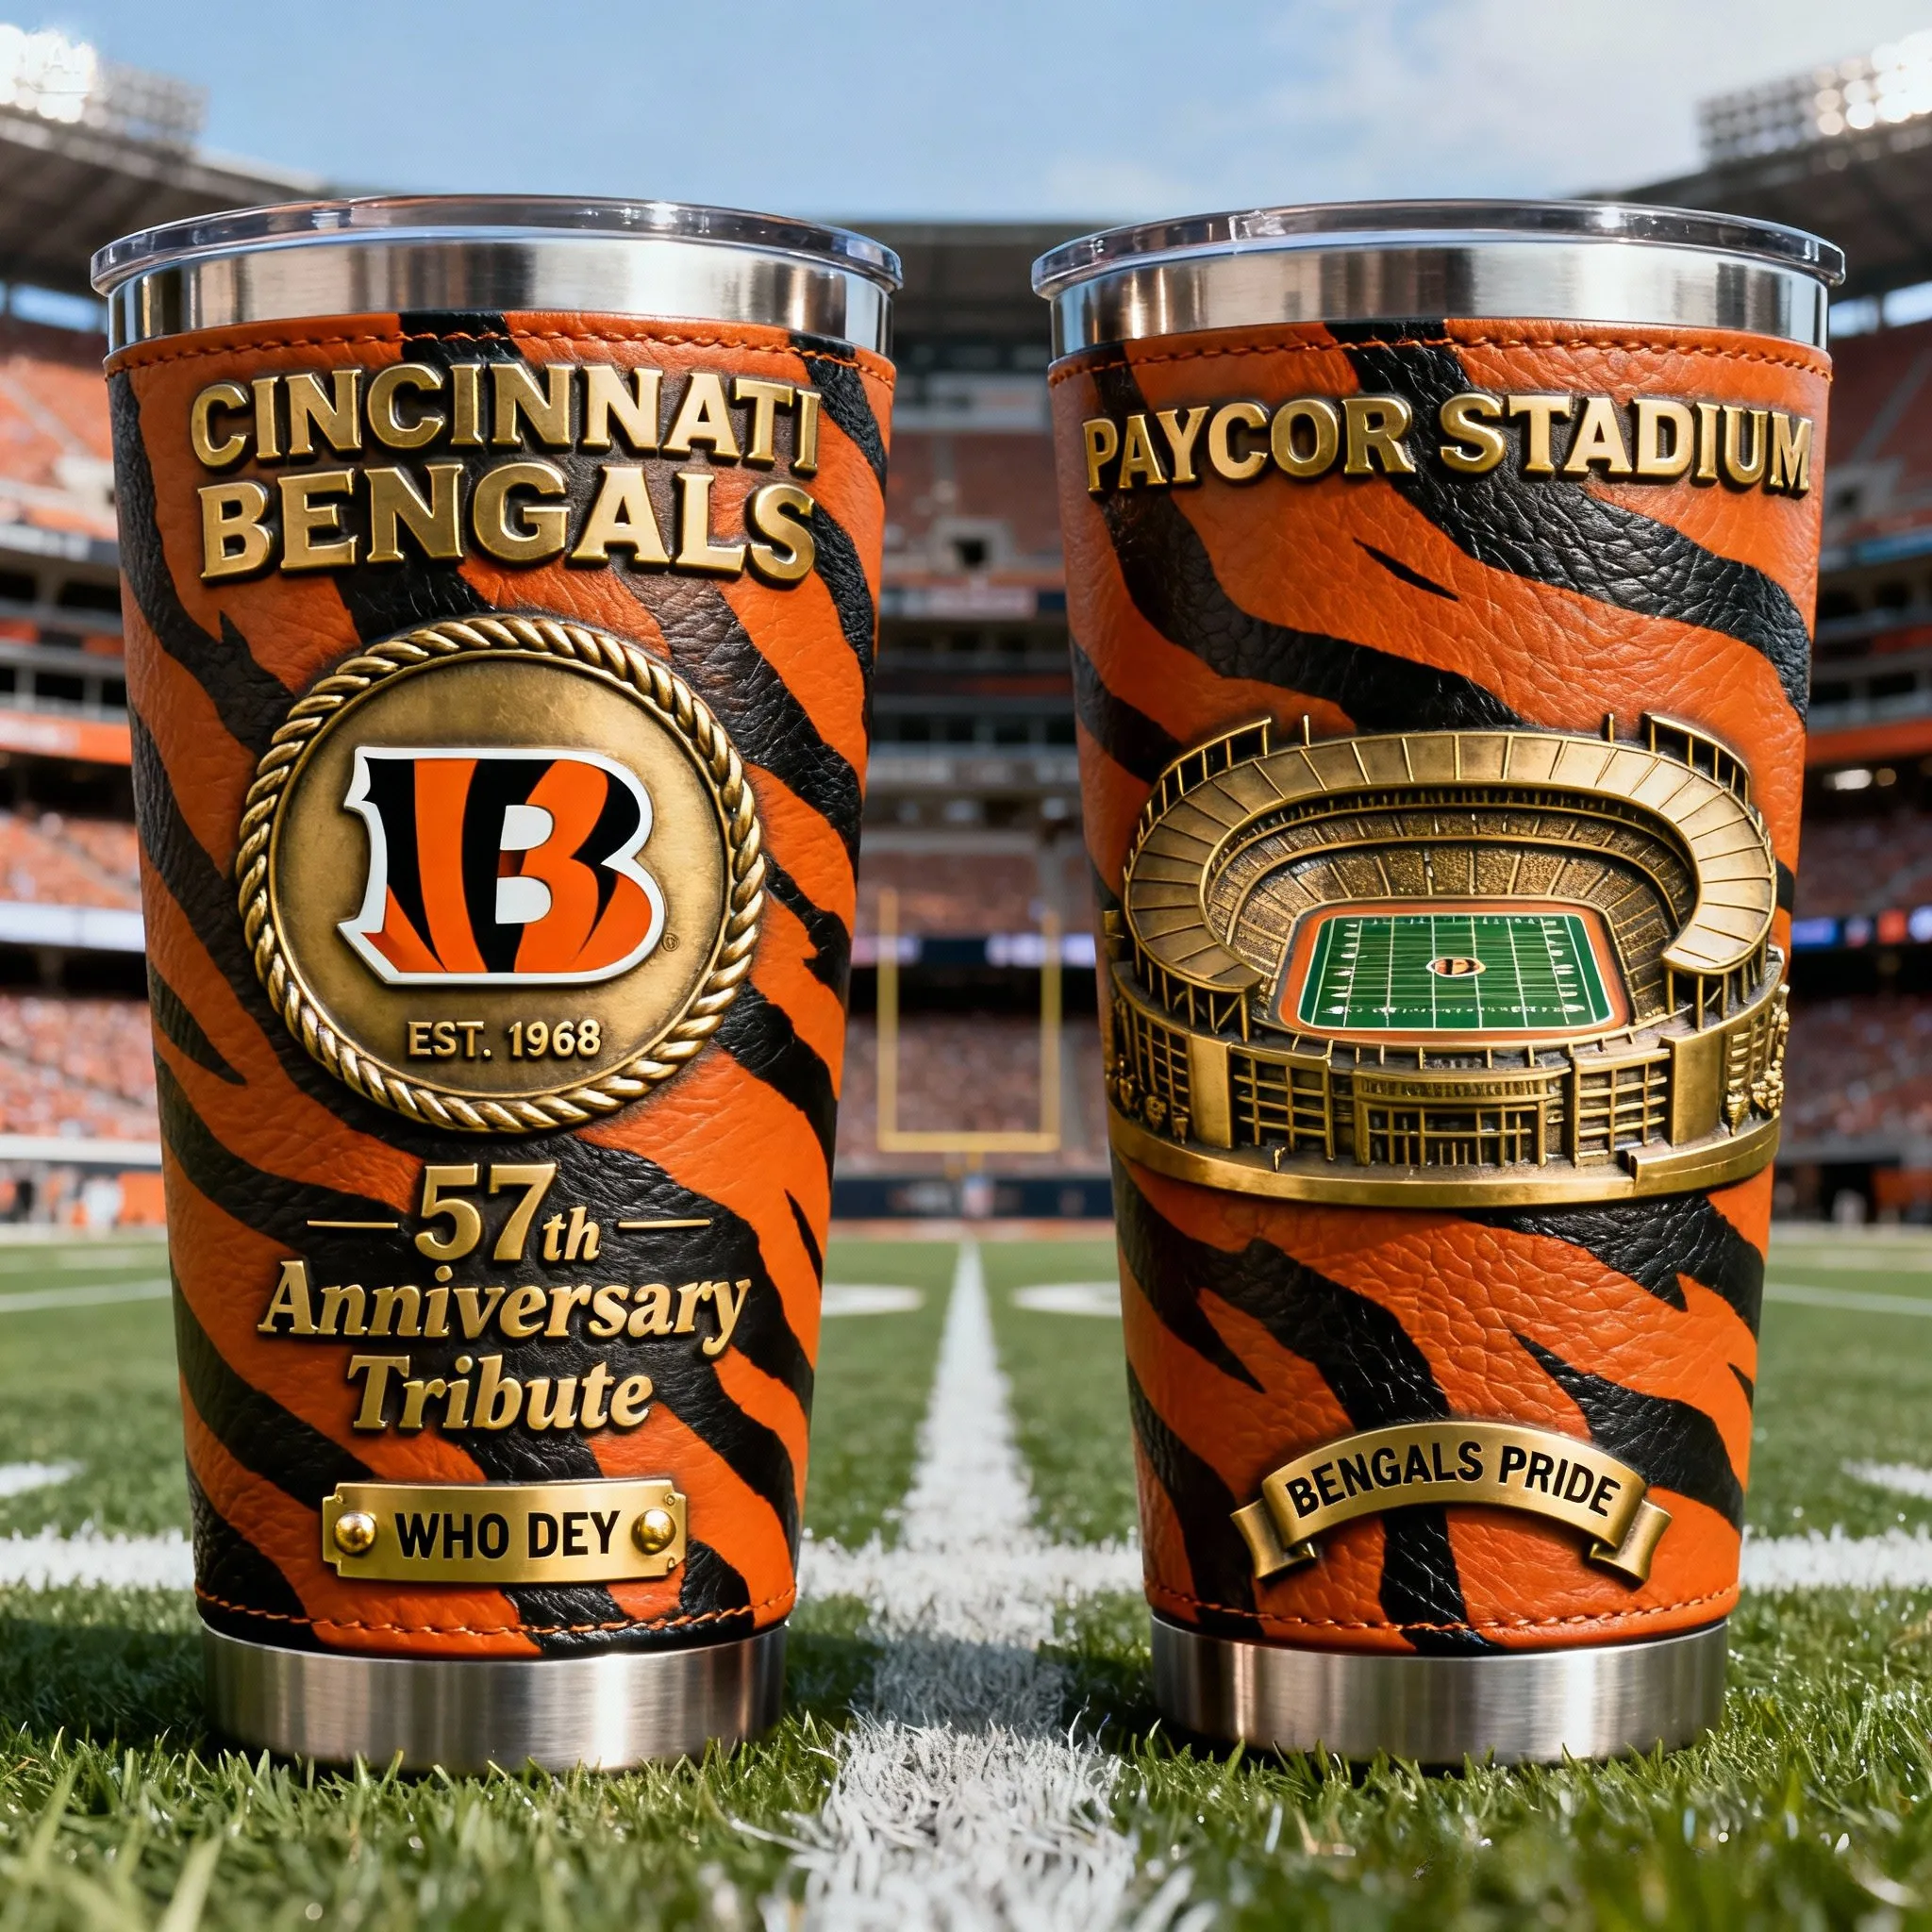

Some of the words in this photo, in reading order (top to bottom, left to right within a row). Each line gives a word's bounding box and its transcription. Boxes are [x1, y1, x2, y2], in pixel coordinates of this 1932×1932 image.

[191, 362, 822, 475] CINCINNATI
[1083, 398, 1417, 493] PAYCOR
[1441, 392, 1812, 496] STADIUM
[197, 462, 817, 580] BENGALS
[408, 1020, 492, 1058] EST.
[508, 1019, 602, 1058] 1968
[414, 1162, 602, 1262] 57th
[258, 1260, 752, 1357] Anniversary
[348, 1355, 653, 1429] Tribute
[1285, 1441, 1484, 1519] BENGALS
[1498, 1445, 1622, 1517] PRIDE
[395, 1512, 509, 1558] WHO
[528, 1510, 620, 1557] DEY
